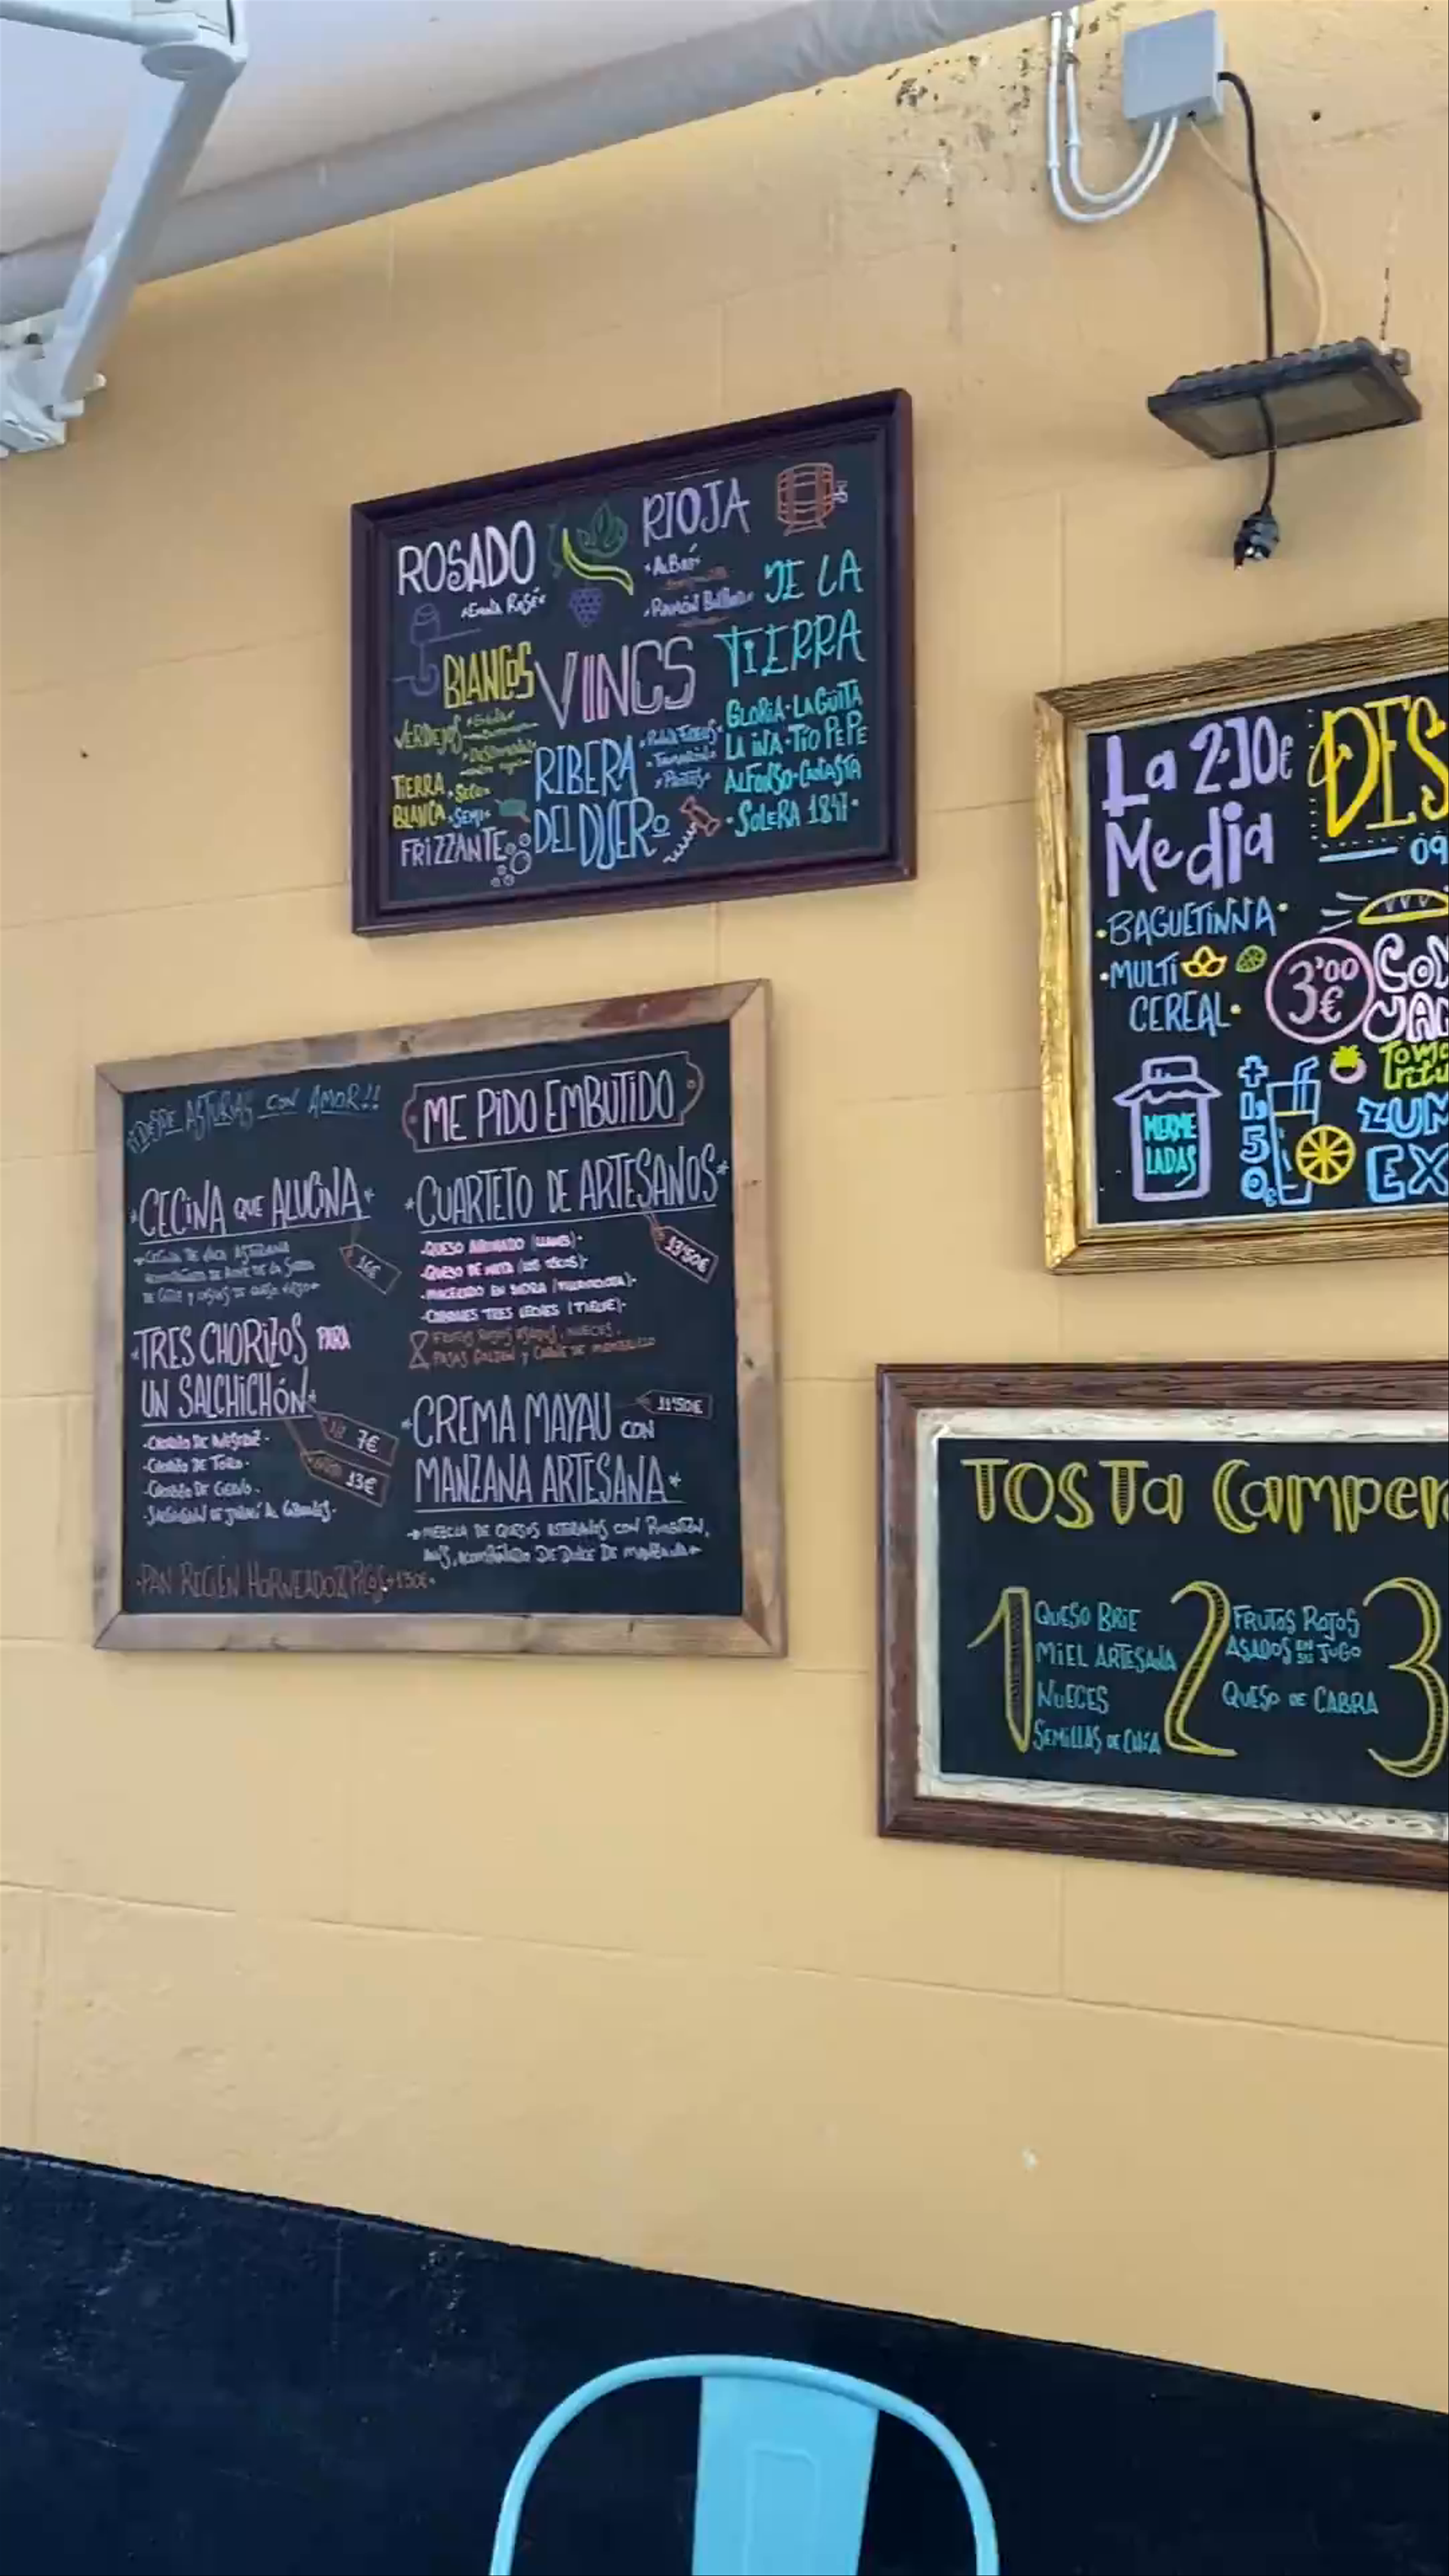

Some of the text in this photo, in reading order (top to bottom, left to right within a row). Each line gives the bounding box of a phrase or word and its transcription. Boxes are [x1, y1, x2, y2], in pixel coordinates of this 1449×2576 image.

[643, 477, 751, 547] RIOJA
[398, 520, 535, 596] ROSADO
[817, 549, 864, 597] LA
[535, 735, 638, 802] RIBERA
[725, 733, 745, 760] LA
[1102, 735, 1177, 817] La
[535, 804, 577, 854] DEL
[734, 799, 800, 838] SOLERA
[1105, 801, 1274, 897] Media
[1129, 990, 1231, 1038] CEREAL
[423, 1069, 674, 1144] ME PIDO EMBUTIDO
[139, 1180, 227, 1238] CECINA
[234, 1195, 264, 1221] QUE
[417, 1143, 719, 1227] CUARTETO DE ARTESANOS
[425, 1241, 465, 1257] QUESO
[133, 1325, 194, 1370] TRES
[199, 1313, 308, 1369] CHORIZOS
[141, 1366, 309, 1419] UN SALCHICHÓN
[413, 1392, 655, 1448] CREMA MAYAU CON
[415, 1452, 668, 1504] MANZANA ARTESANA
[1212, 1458, 1449, 1534] Camper
[1035, 1600, 1091, 1629] QUESO
[1232, 1604, 1360, 1641] FRUTOS ROJOS
[967, 1587, 1033, 1753] 1
[1164, 1580, 1238, 1758] 2
[1225, 1635, 1293, 1665] ASADOS
[1362, 1576, 1449, 1779] 3
[1037, 1679, 1110, 1715] NUECES
[1221, 1680, 1281, 1712] QUESO
[1313, 1685, 1380, 1716] CABRA
